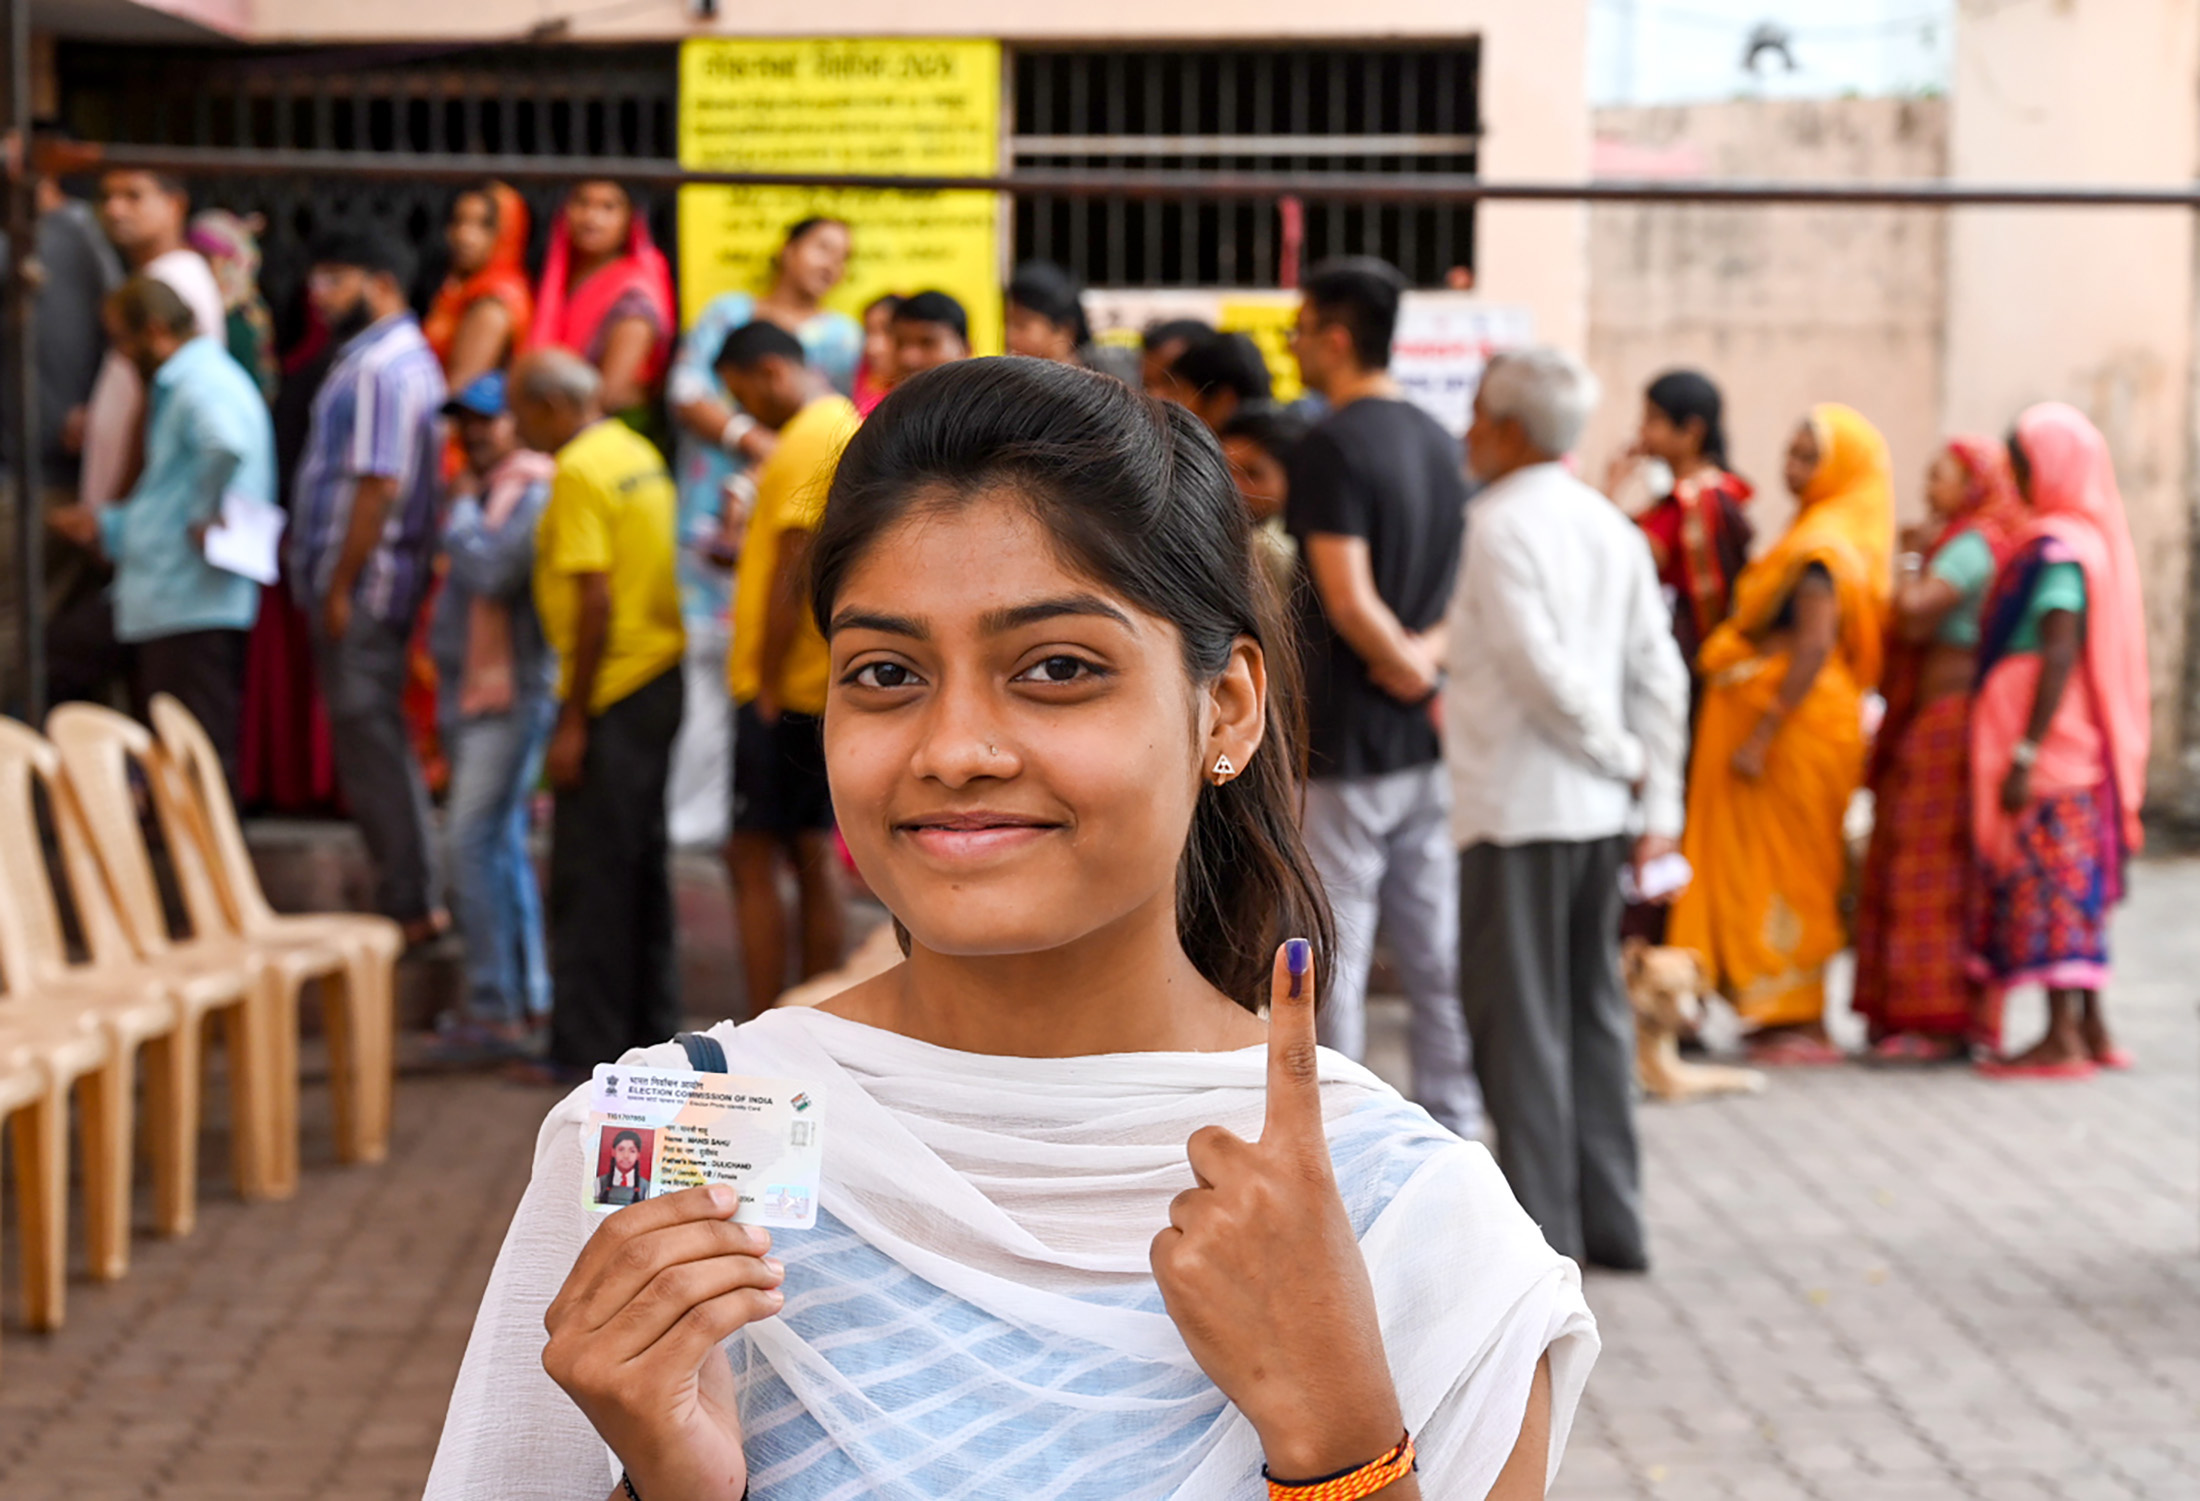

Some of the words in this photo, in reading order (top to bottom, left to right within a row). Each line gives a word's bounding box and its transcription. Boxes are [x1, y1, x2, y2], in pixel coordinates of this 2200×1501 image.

[628, 1086, 673, 1096] ELECTION
[675, 1090, 732, 1101] COMMISSION
[734, 1094, 746, 1102] OF
[749, 1096, 773, 1105] INDIA
